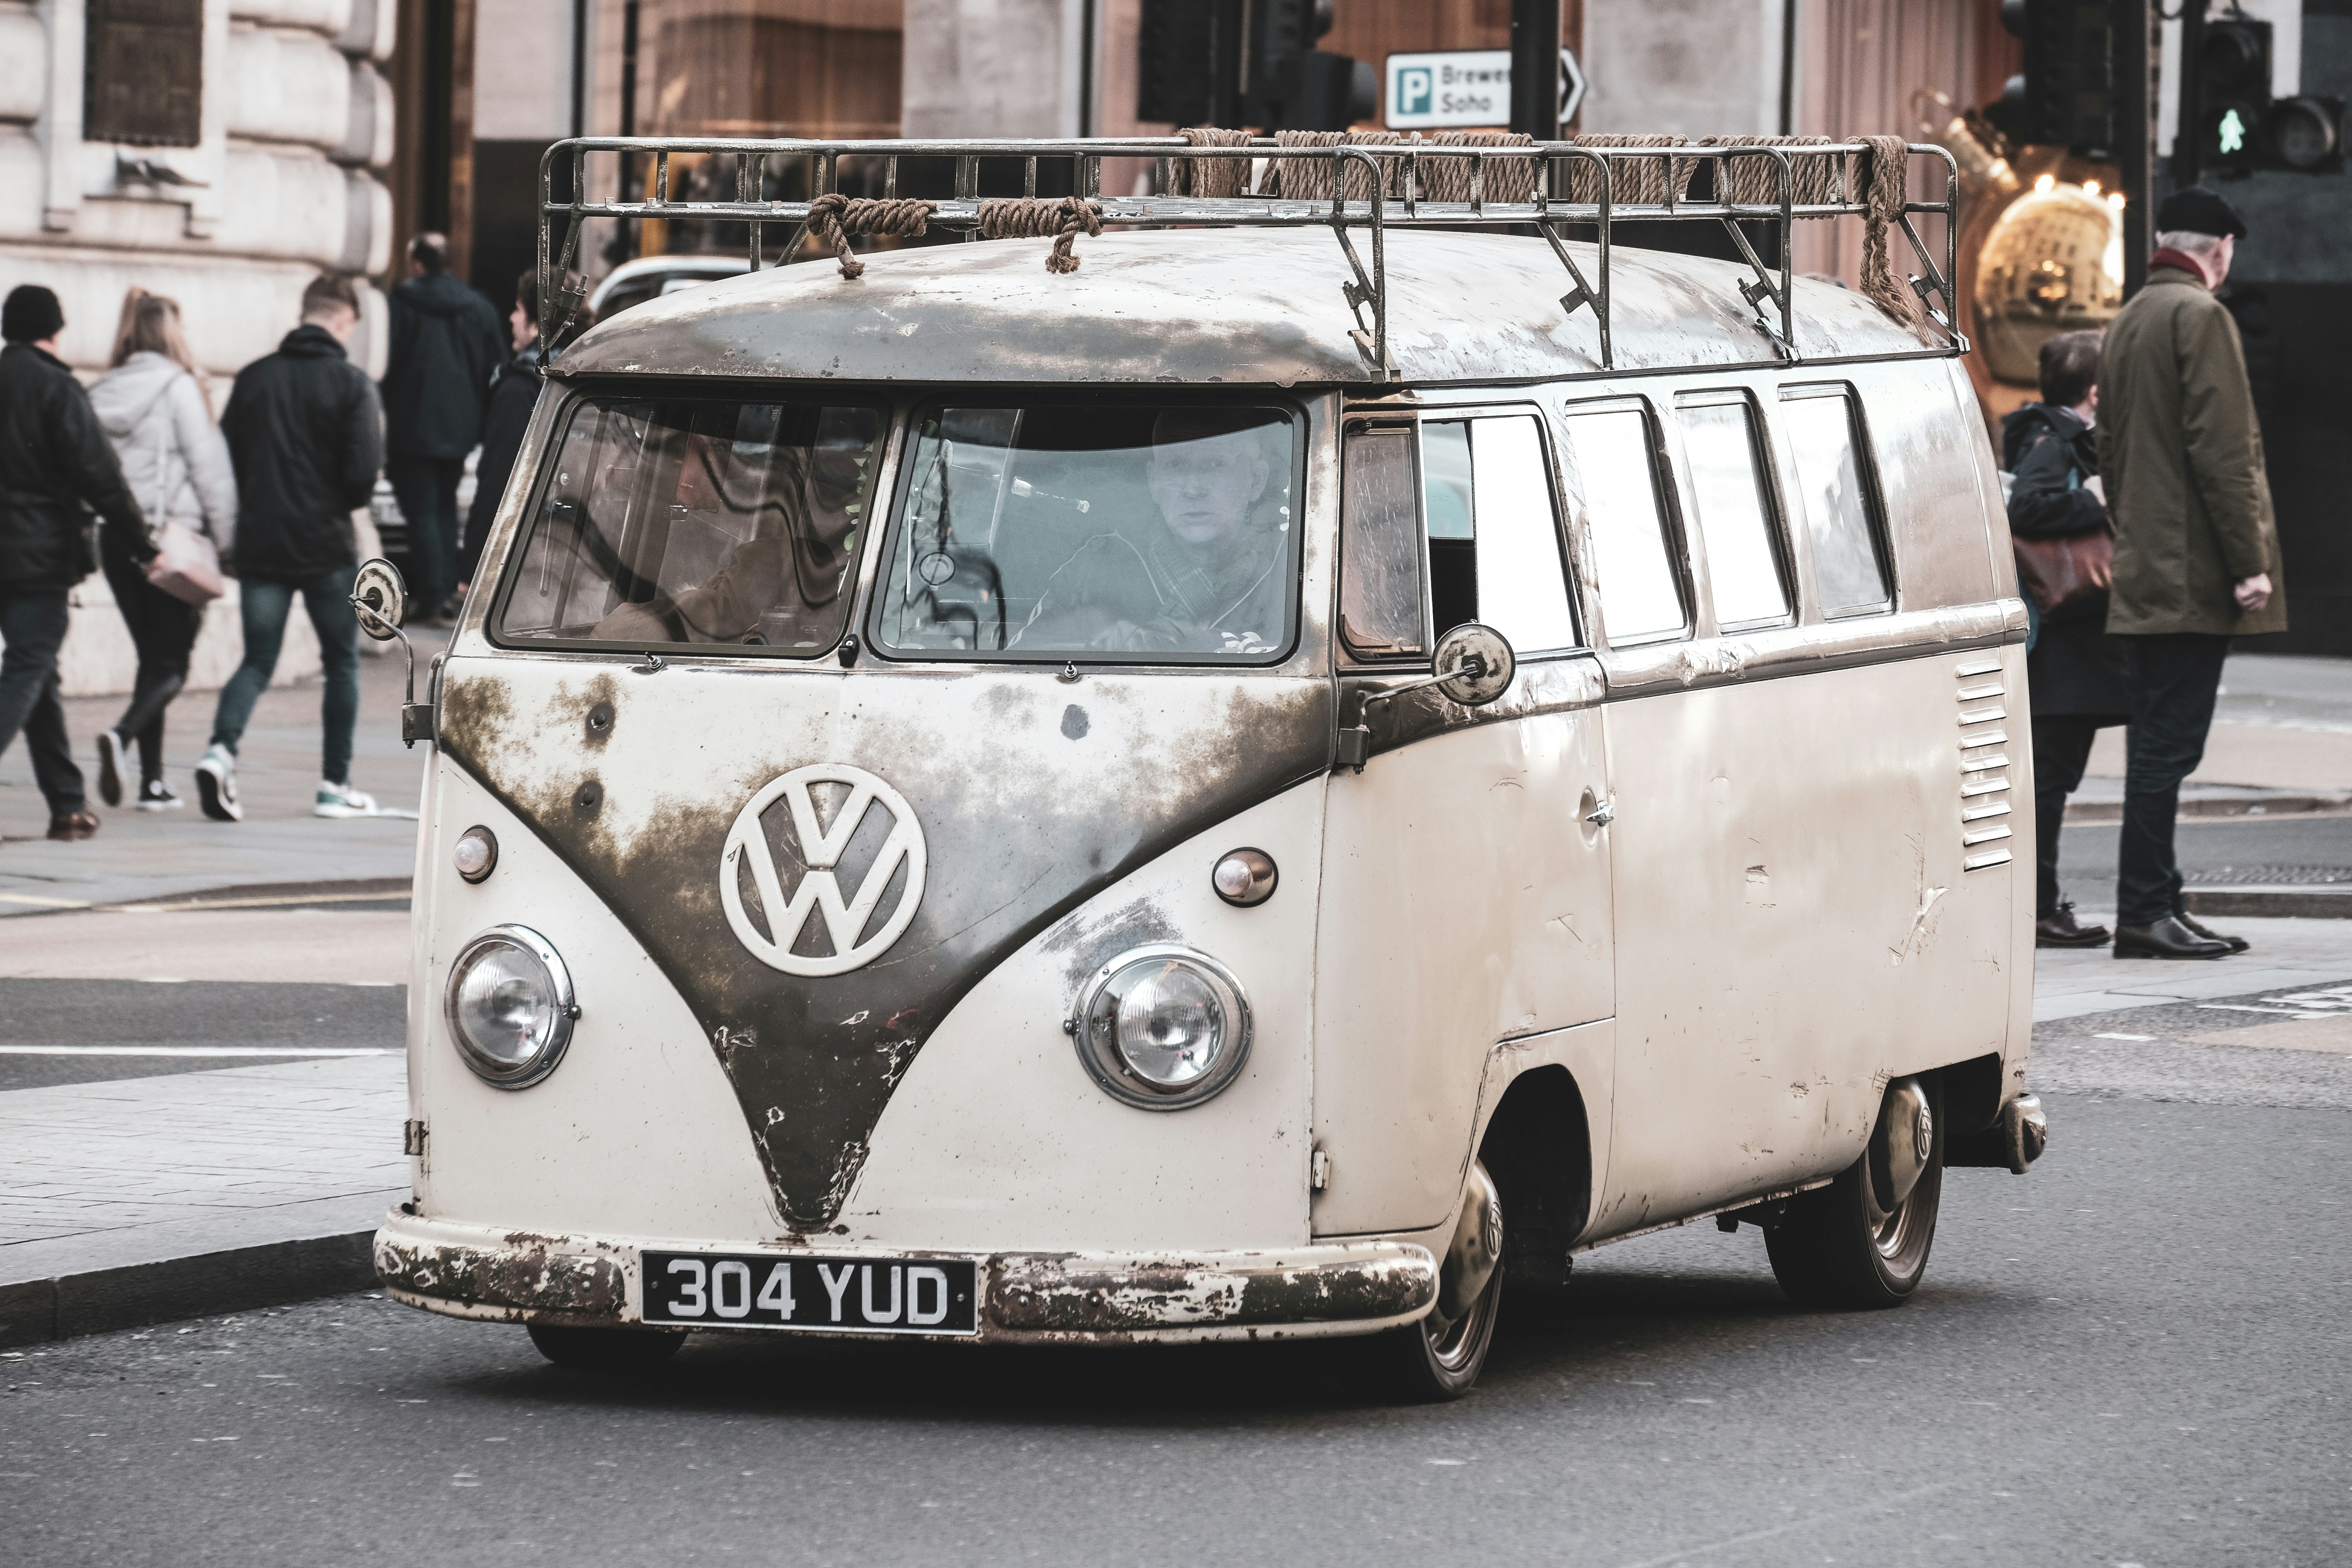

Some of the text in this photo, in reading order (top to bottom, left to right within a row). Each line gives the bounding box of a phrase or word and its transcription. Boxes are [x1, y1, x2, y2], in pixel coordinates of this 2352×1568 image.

[1403, 70, 1429, 111] P
[1441, 92, 1491, 113] Soho
[731, 771, 919, 968] VW
[667, 1259, 948, 1325] 304 YUD
